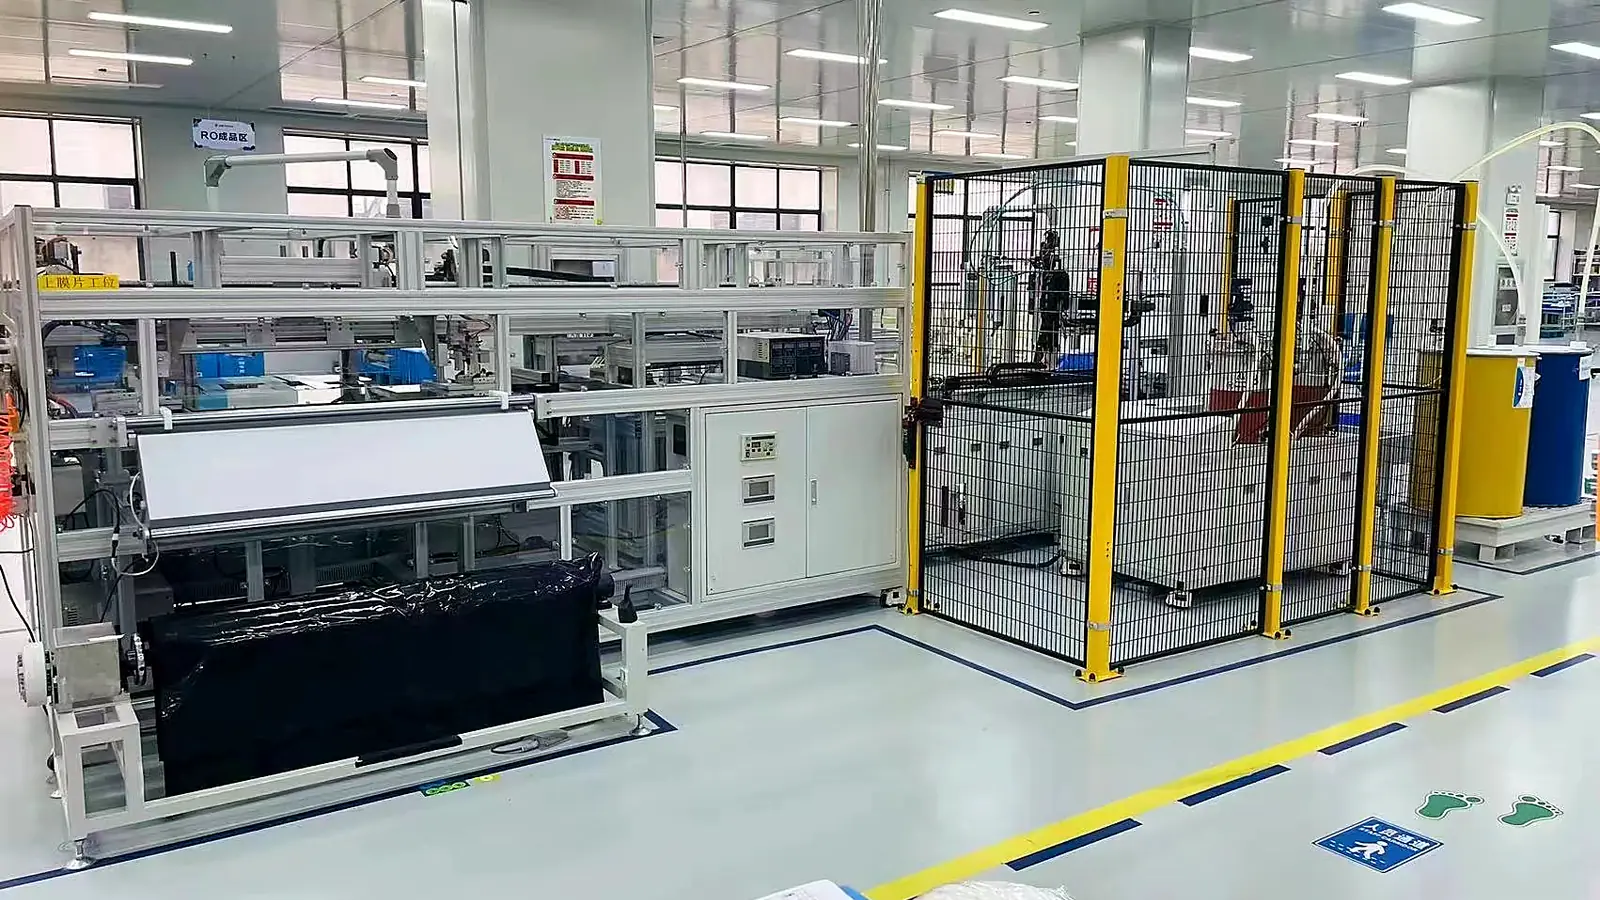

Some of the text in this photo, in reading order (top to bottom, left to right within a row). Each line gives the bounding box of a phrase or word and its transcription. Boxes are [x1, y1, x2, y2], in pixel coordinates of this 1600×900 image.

[201, 131, 248, 142] RO成品区
[43, 275, 117, 290] 上膜片工位
[1363, 823, 1431, 850] 人员通道
